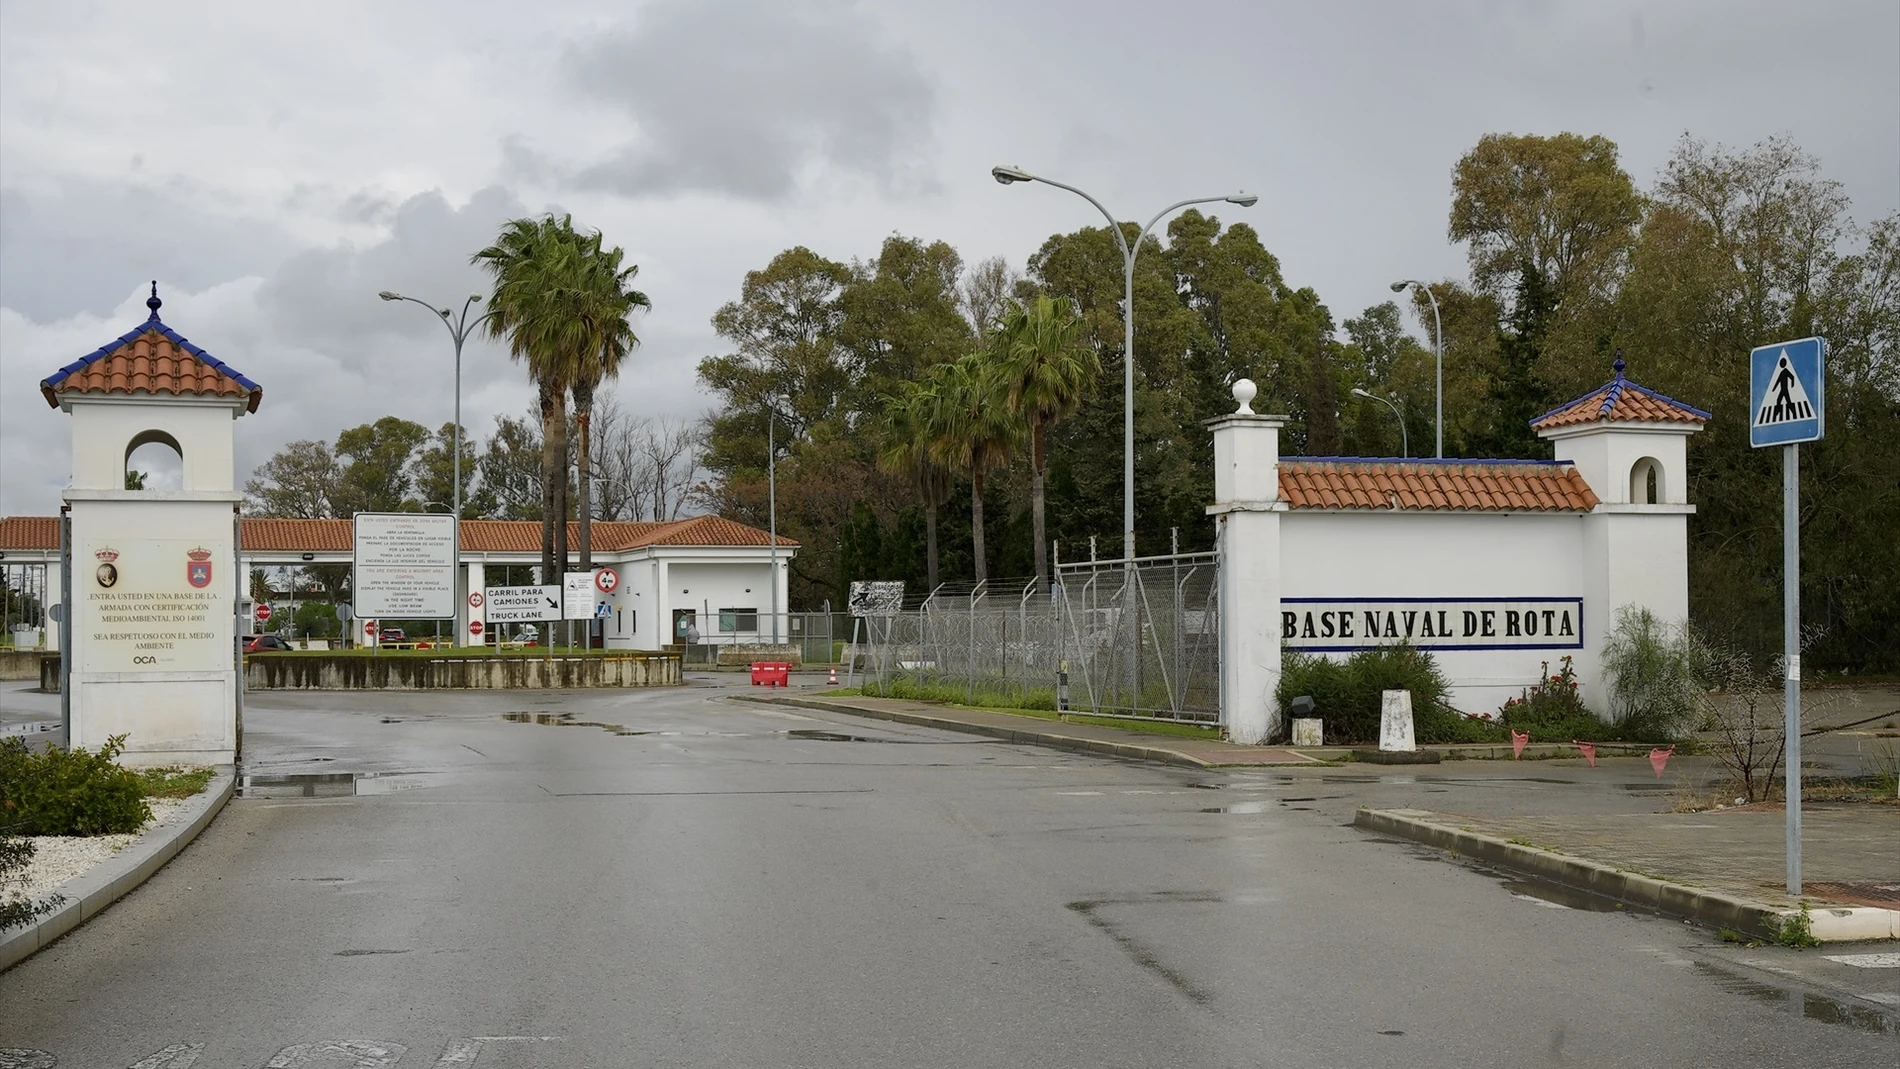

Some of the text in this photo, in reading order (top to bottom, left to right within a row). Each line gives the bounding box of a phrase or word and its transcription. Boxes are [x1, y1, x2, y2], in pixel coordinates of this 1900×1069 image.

[488, 588, 519, 597] CARRIL
[1281, 610, 1575, 639] BASE NAVAL DE ROTA
[133, 656, 156, 664] OCA
